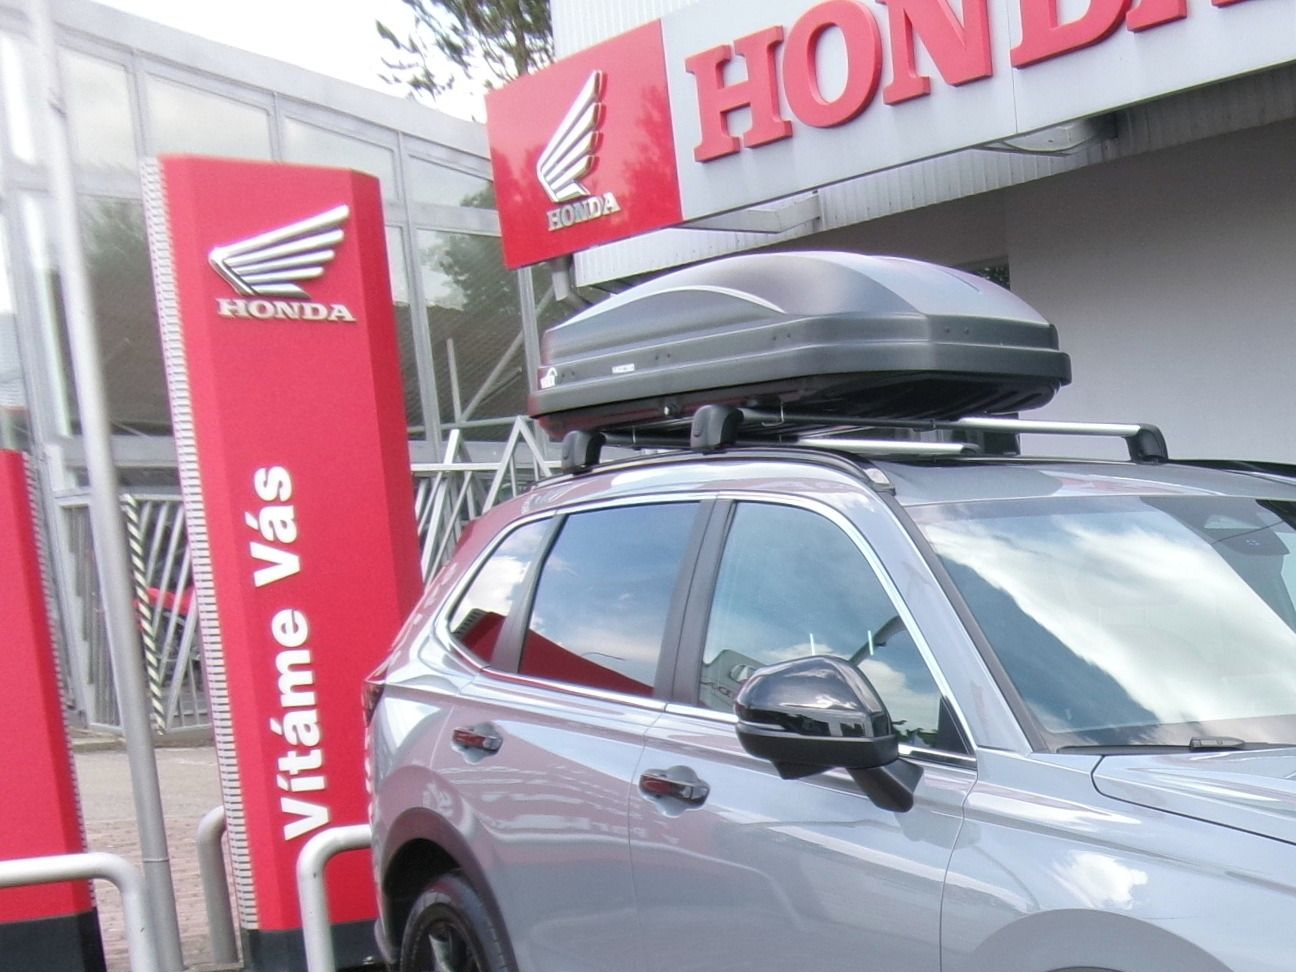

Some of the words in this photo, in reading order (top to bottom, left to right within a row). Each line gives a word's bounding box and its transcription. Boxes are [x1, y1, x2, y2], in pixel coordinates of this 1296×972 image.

[685, 0, 1254, 163] HOND
[546, 192, 621, 232] HONDA
[215, 298, 357, 322] HONDA
[244, 465, 301, 588] Vás
[269, 608, 331, 841] Vítáme
